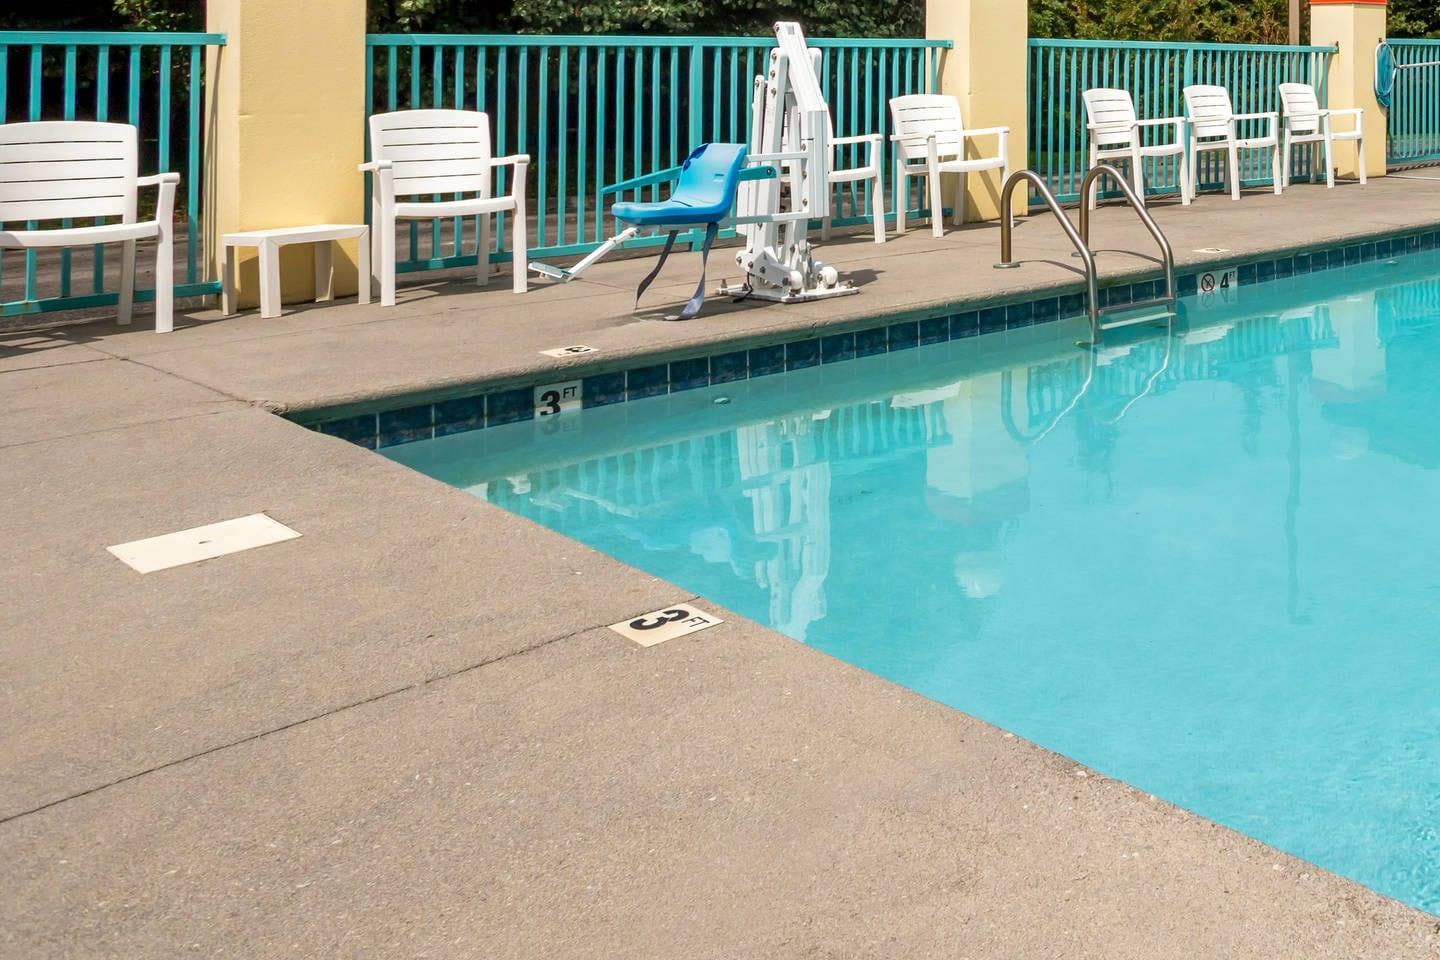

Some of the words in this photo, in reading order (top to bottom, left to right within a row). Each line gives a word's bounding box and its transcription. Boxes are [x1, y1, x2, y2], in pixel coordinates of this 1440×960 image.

[1220, 272, 1229, 288] 4
[1229, 271, 1236, 279] FT
[540, 390, 561, 416] 3
[563, 386, 577, 398] FT
[629, 609, 690, 630] 3
[681, 616, 710, 627] FT
